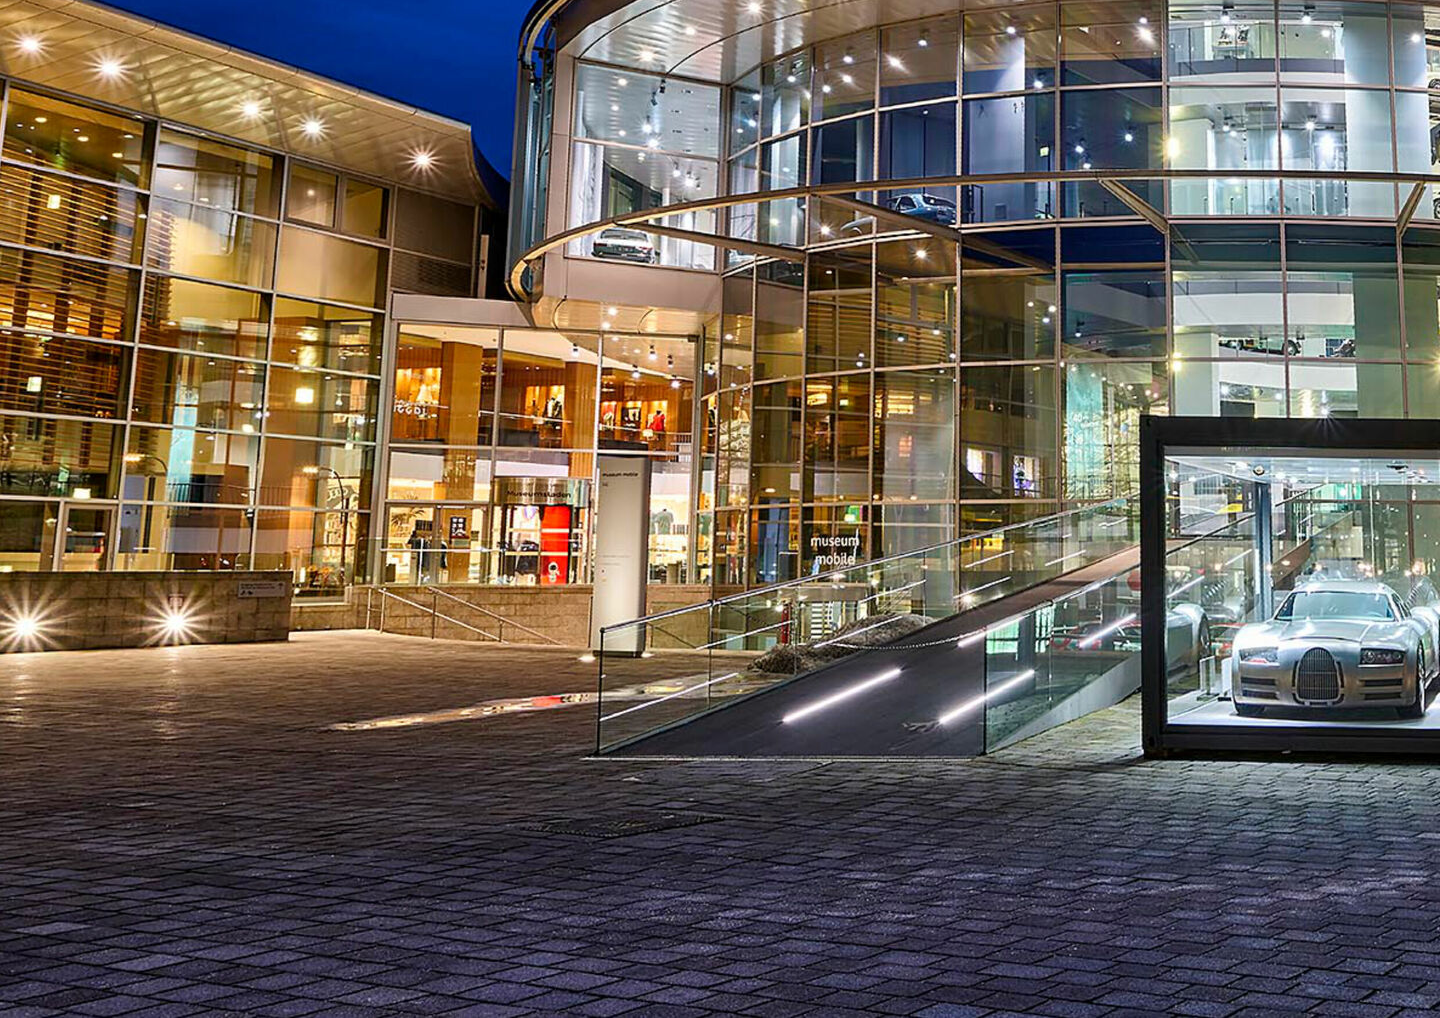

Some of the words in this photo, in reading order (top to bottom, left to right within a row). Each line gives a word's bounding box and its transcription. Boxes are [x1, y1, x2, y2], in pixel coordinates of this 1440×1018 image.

[507, 490, 571, 498] Museumsladen
[810, 536, 860, 547] museum
[815, 552, 856, 565] mobile
